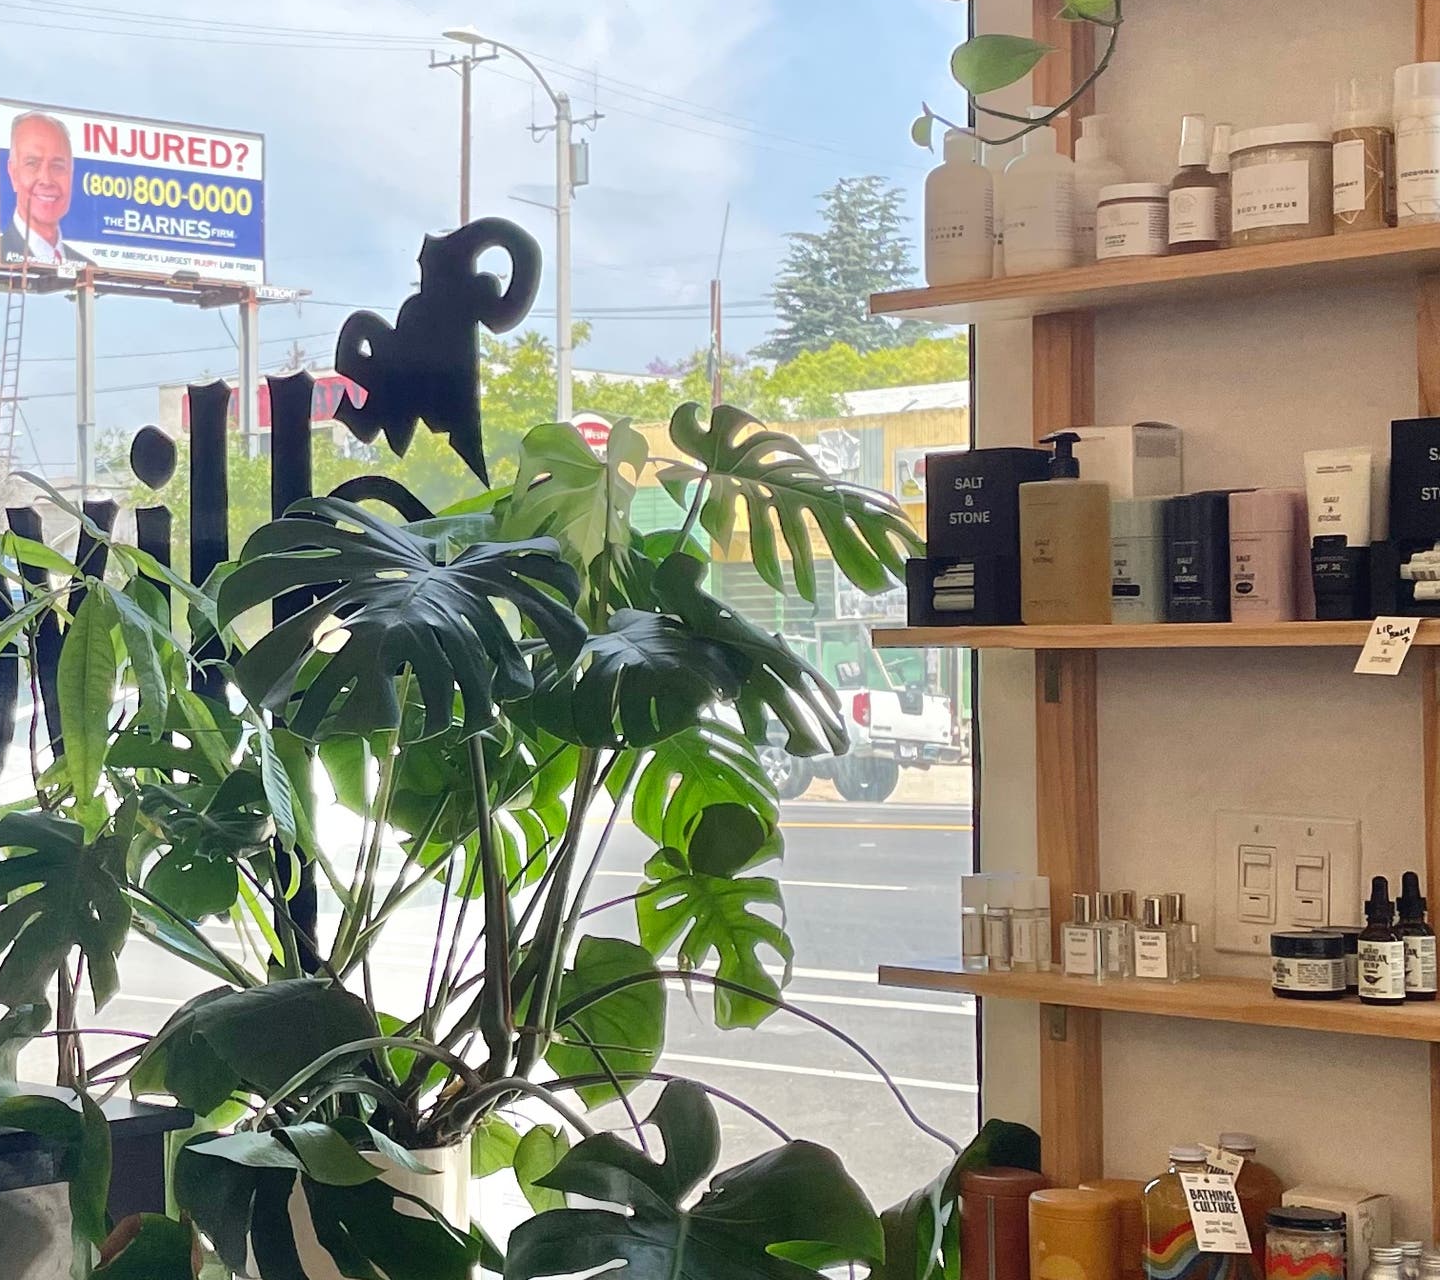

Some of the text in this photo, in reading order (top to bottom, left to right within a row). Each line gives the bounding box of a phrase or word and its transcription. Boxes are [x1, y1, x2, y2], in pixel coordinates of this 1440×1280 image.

[83, 122, 250, 172] INJURED?
[82, 172, 253, 216] (800)800-0000
[104, 209, 235, 239] THE BARNES FIRM
[92, 248, 108, 258] ONE
[110, 250, 120, 258] OF
[121, 251, 160, 263] AMERICA'S
[160, 256, 192, 266] LARGEST
[219, 261, 235, 269] LAW
[235, 263, 257, 272] FIRMS
[255, 286, 300, 300] UTFRONT
[954, 476, 984, 490] SALT
[964, 494, 974, 507] &
[949, 510, 991, 525] STONE
[1376, 624, 1394, 635] LIP
[1189, 1188, 1235, 1203] BATHING
[1192, 1200, 1239, 1214] CULTURE
